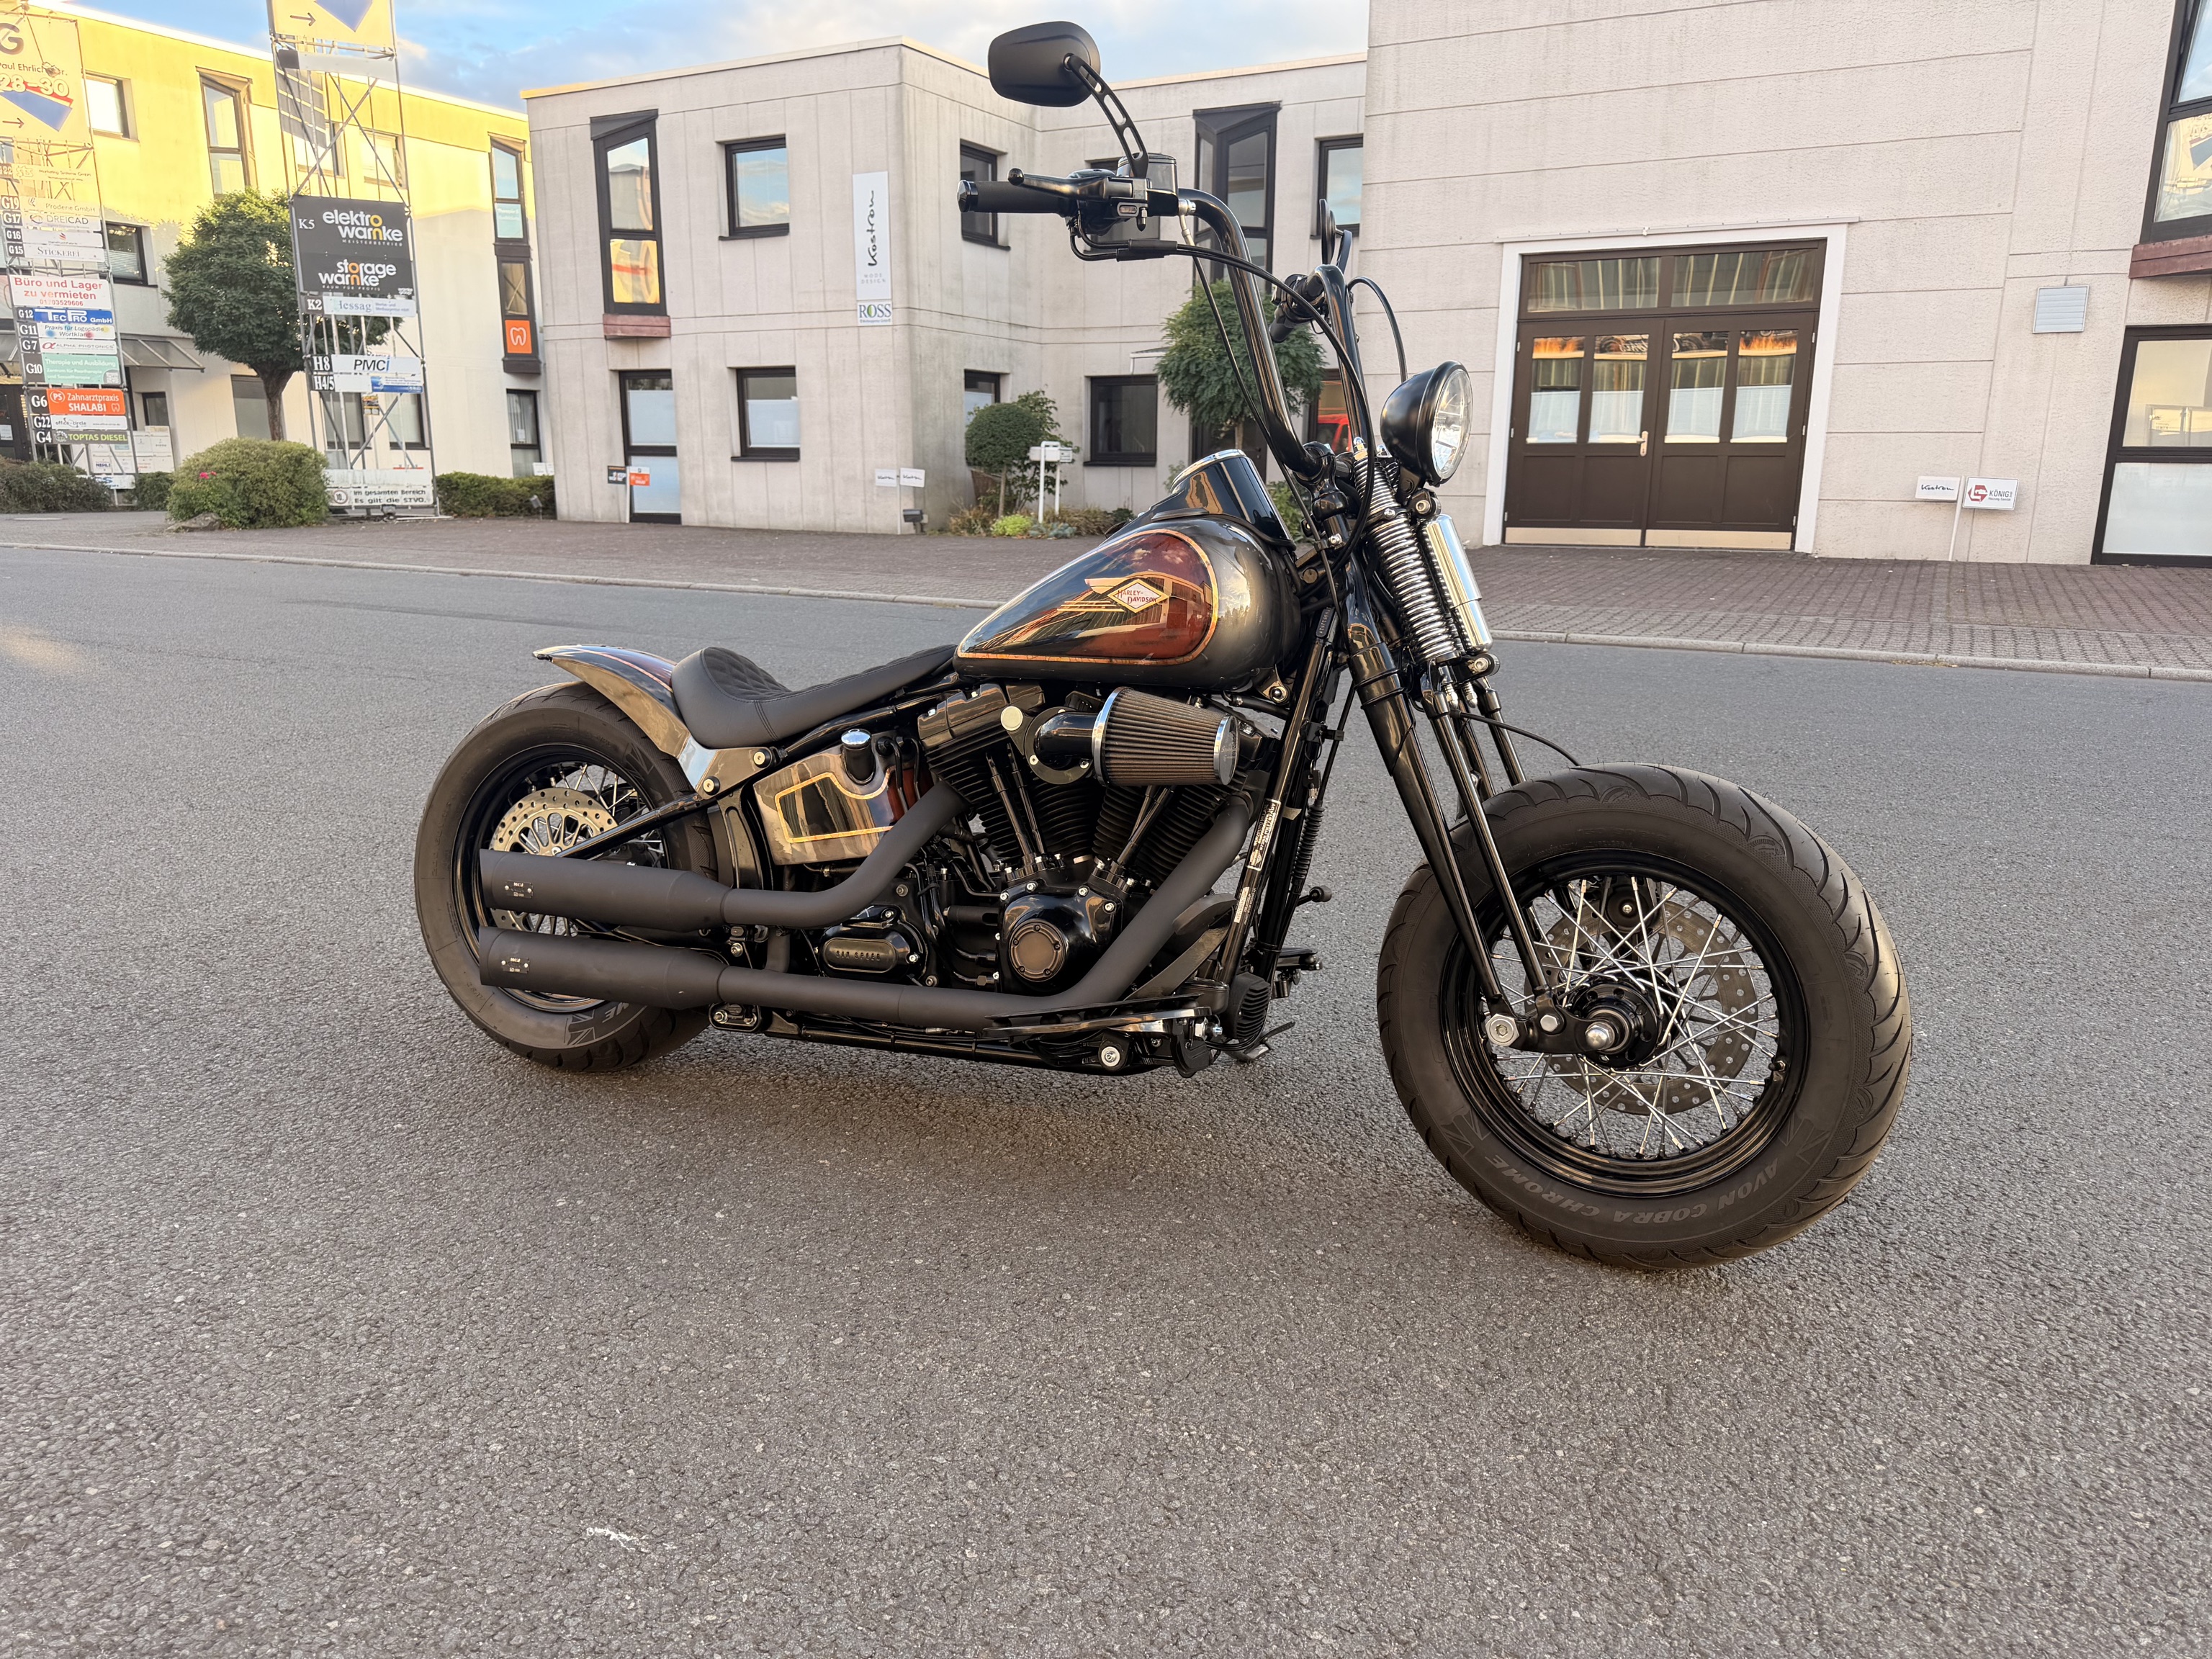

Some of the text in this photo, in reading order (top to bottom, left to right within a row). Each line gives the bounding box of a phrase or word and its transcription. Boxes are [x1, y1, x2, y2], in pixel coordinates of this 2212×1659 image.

[0, 166, 12, 175] 22
[1, 197, 19, 210] G19
[3, 212, 21, 225] G17
[46, 215, 89, 225] DREICAD
[297, 218, 315, 230] K5
[322, 210, 383, 228] elektro
[6, 231, 21, 240] G16
[338, 225, 403, 242] warnke
[9, 246, 24, 254] G15
[336, 258, 397, 279] storage
[14, 277, 102, 291] Büro und Lager
[318, 272, 379, 287] warnke
[40, 290, 96, 300] vermieten
[307, 299, 323, 310] K2
[18, 309, 34, 318] G12
[858, 304, 892, 318] ROSS
[19, 324, 38, 335] G11
[22, 340, 37, 350] G7
[26, 363, 42, 374] G10
[313, 356, 331, 371] H8
[354, 357, 390, 371] PMCi
[313, 375, 335, 390] H4/5
[31, 395, 48, 408] G6
[67, 393, 119, 403] Zahnarztpraxis
[68, 403, 107, 412] SHALABI
[34, 416, 51, 428] G22
[36, 432, 52, 443] G4
[1989, 489, 2009, 498] KÖNIG
[1118, 590, 1143, 598] HARLEY-
[1484, 1154, 1779, 1224] AVON COBRA CHROME
